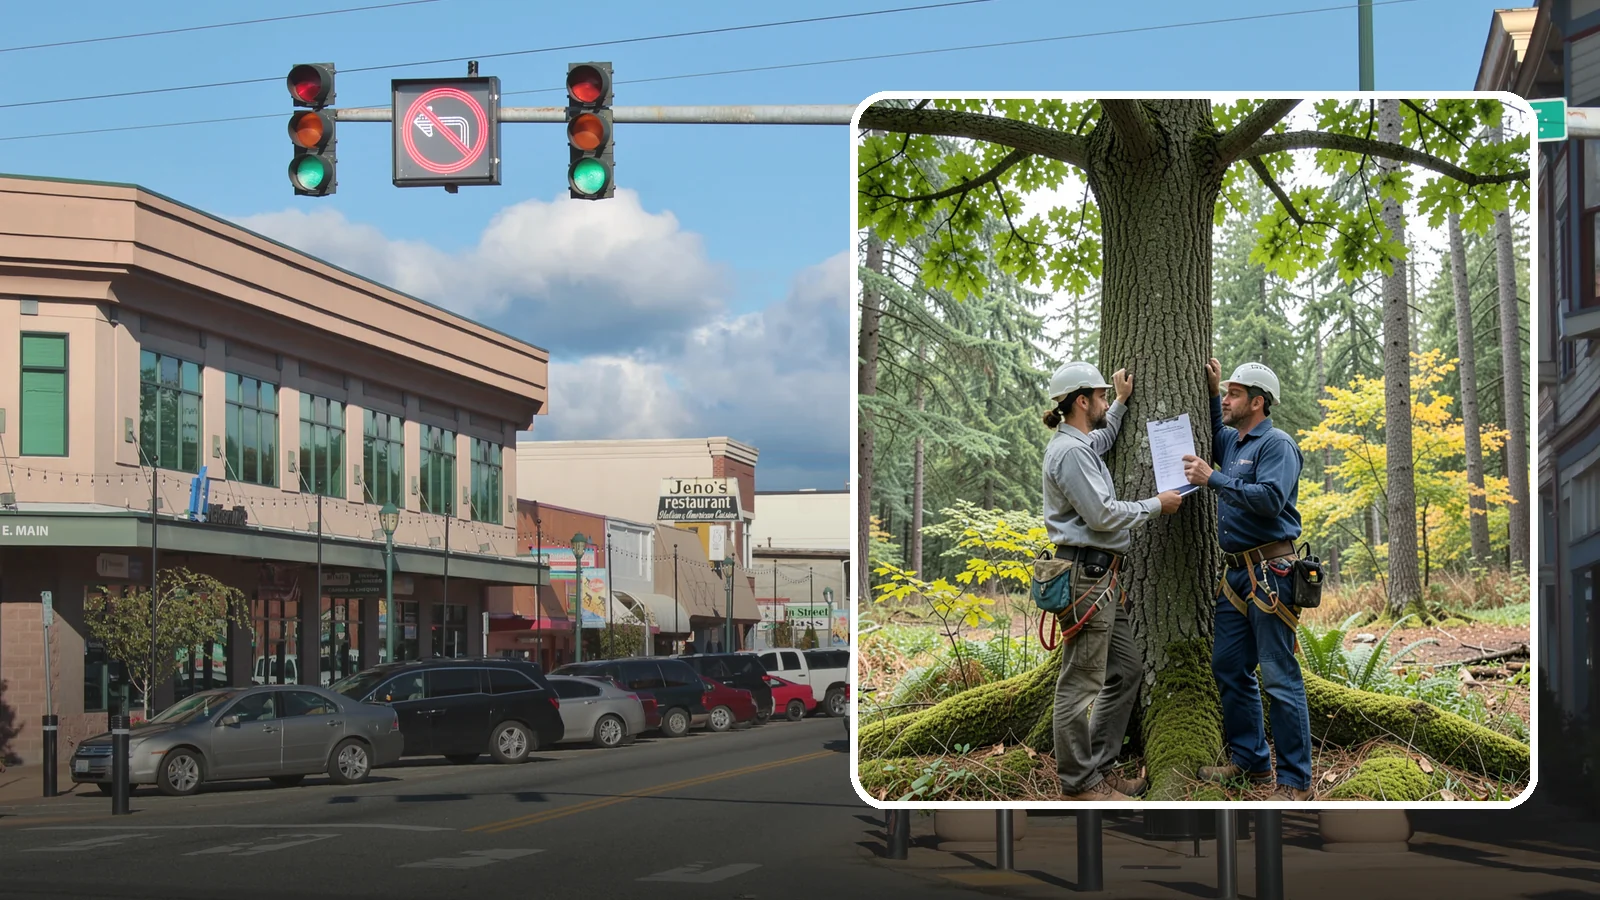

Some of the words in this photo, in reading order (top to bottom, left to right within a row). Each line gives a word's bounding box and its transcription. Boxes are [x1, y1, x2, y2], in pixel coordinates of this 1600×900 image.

[669, 480, 727, 494] Jeno's
[665, 496, 731, 509] restaurant
[658, 510, 682, 520] Italian
[686, 510, 715, 519] American
[715, 509, 738, 519] Cuisine
[2, 525, 13, 536] E.
[15, 525, 49, 536] MAIN
[797, 607, 828, 617] Street
[791, 619, 823, 627] lass
